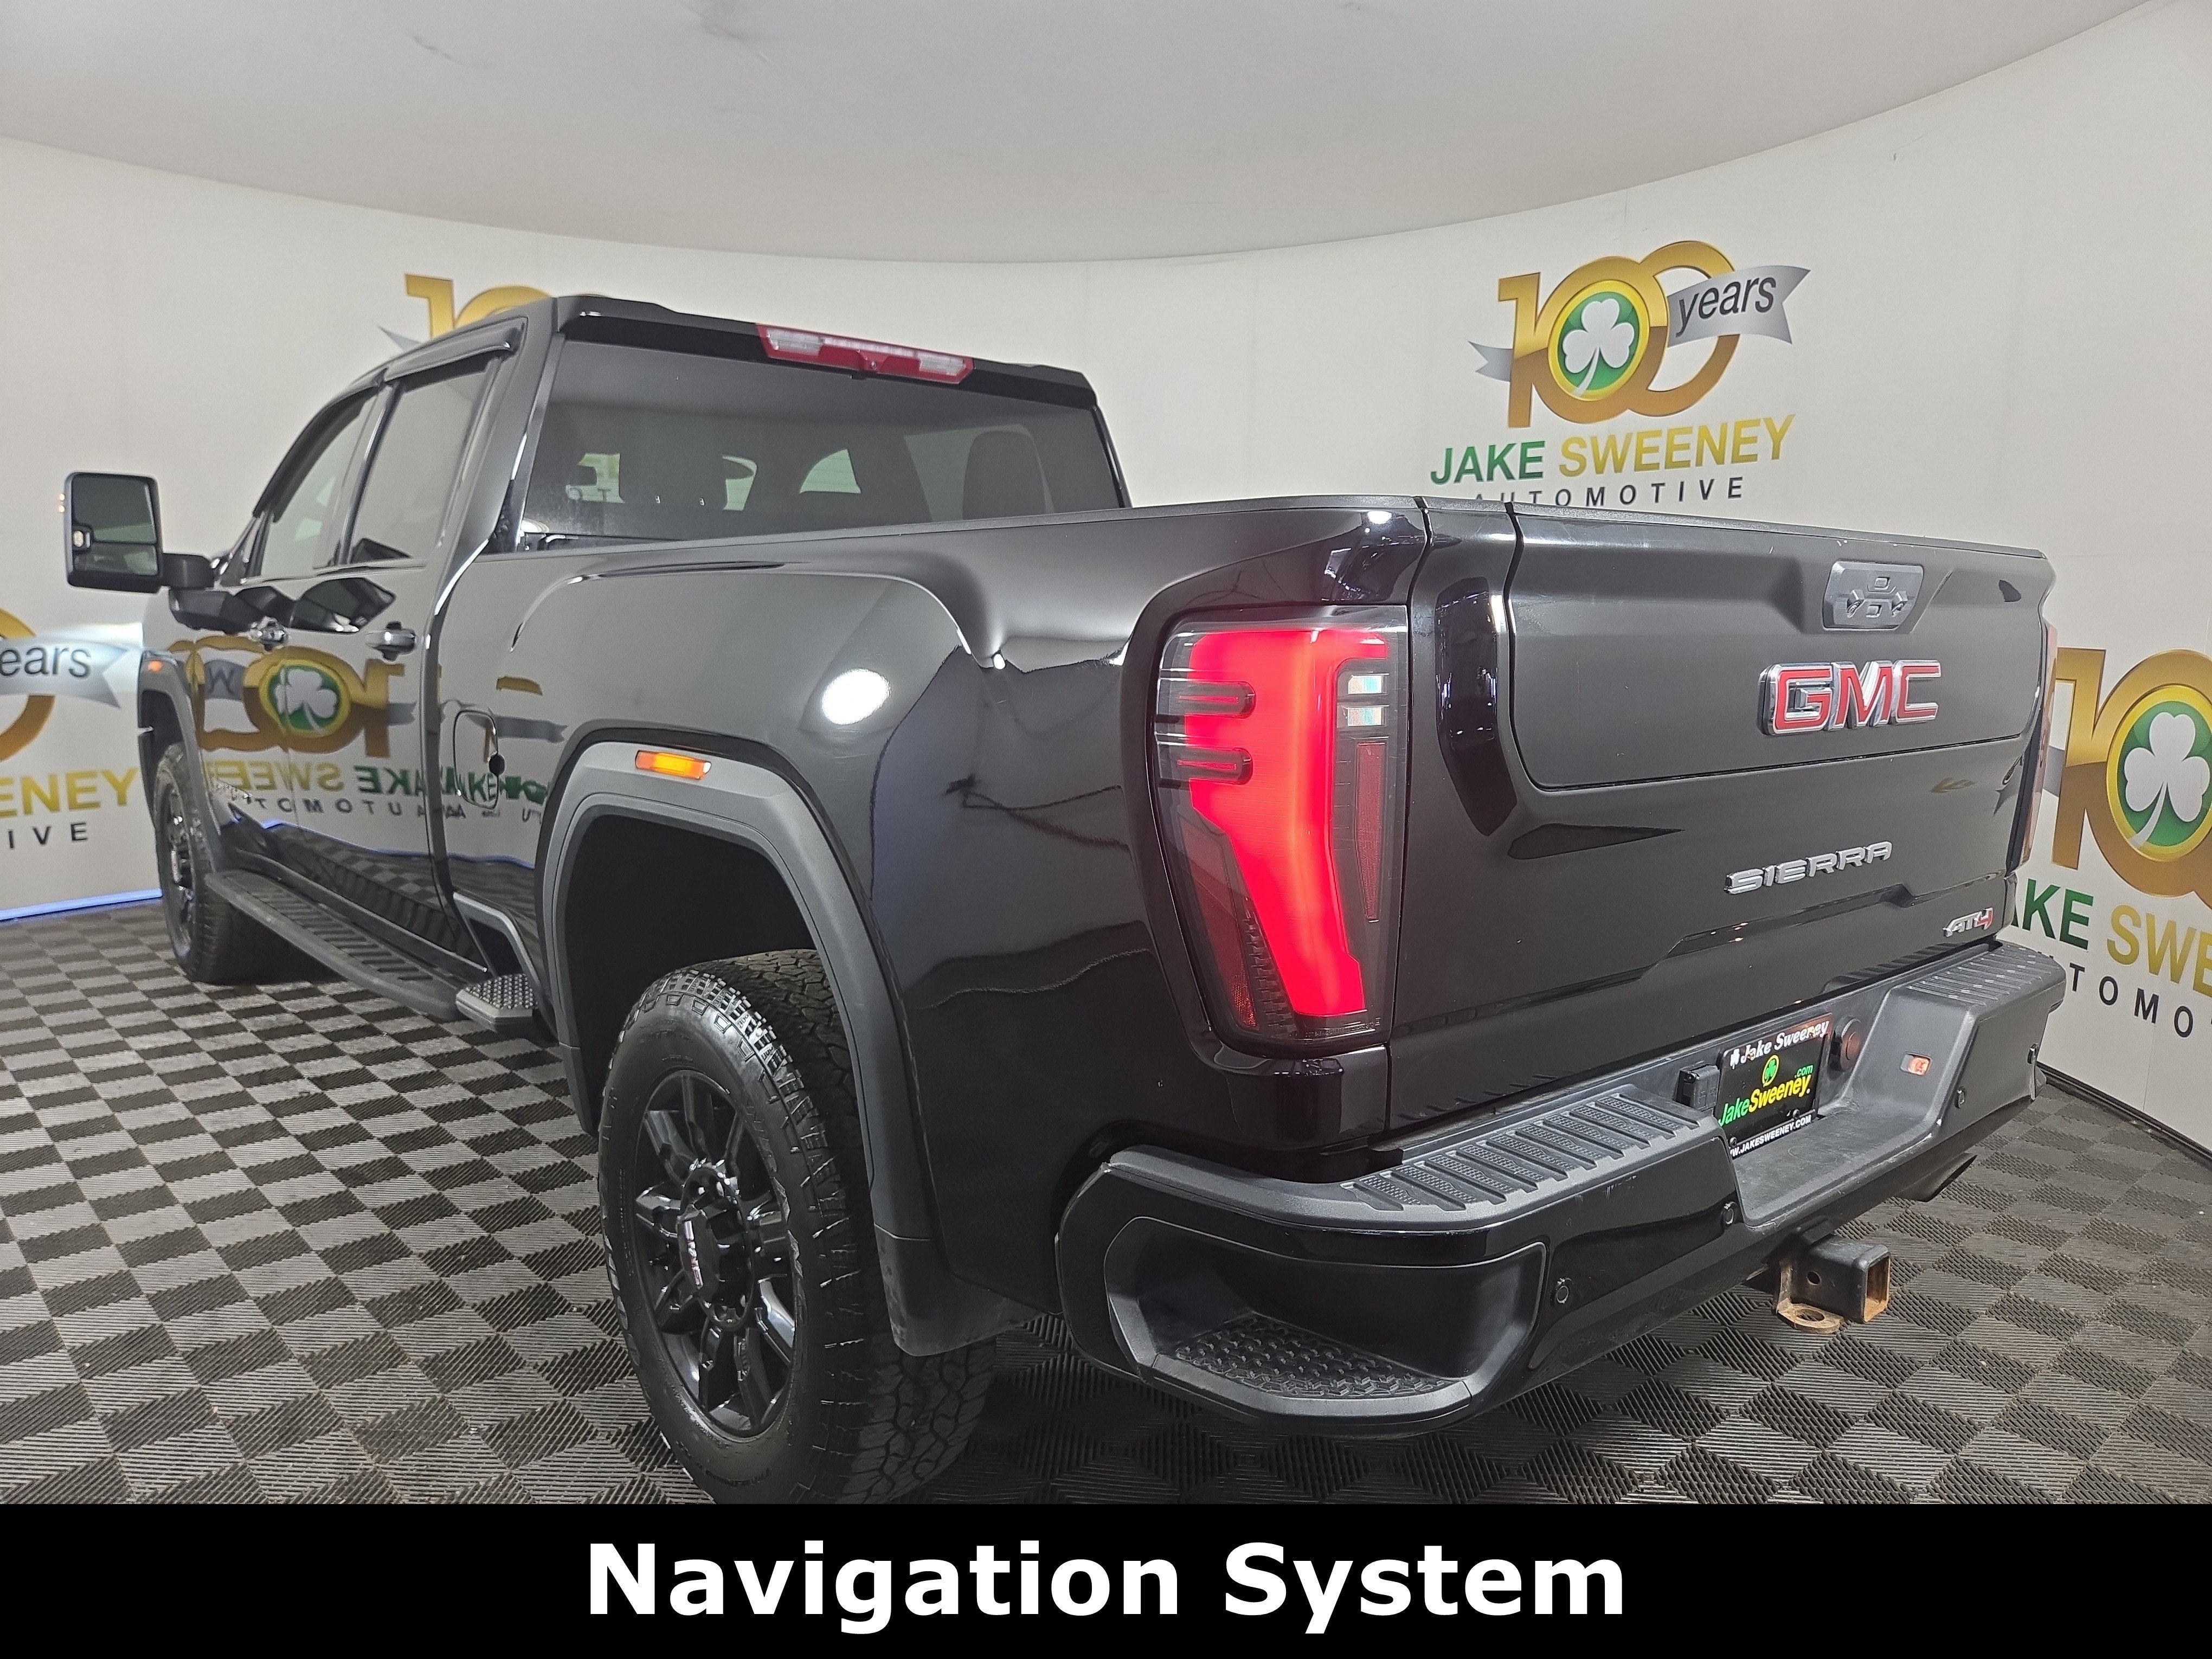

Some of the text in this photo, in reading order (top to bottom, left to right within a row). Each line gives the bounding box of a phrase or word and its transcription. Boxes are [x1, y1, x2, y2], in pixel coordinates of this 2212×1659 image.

[1498, 240, 1777, 428] 100 years
[1430, 414, 1796, 485] JAKE SWEENEY
[1758, 659, 1941, 736] GMC
[1723, 841, 1893, 895] SIERRA
[1943, 907, 1994, 937] AT4
[1740, 1020, 1830, 1064] Jake Sweeney
